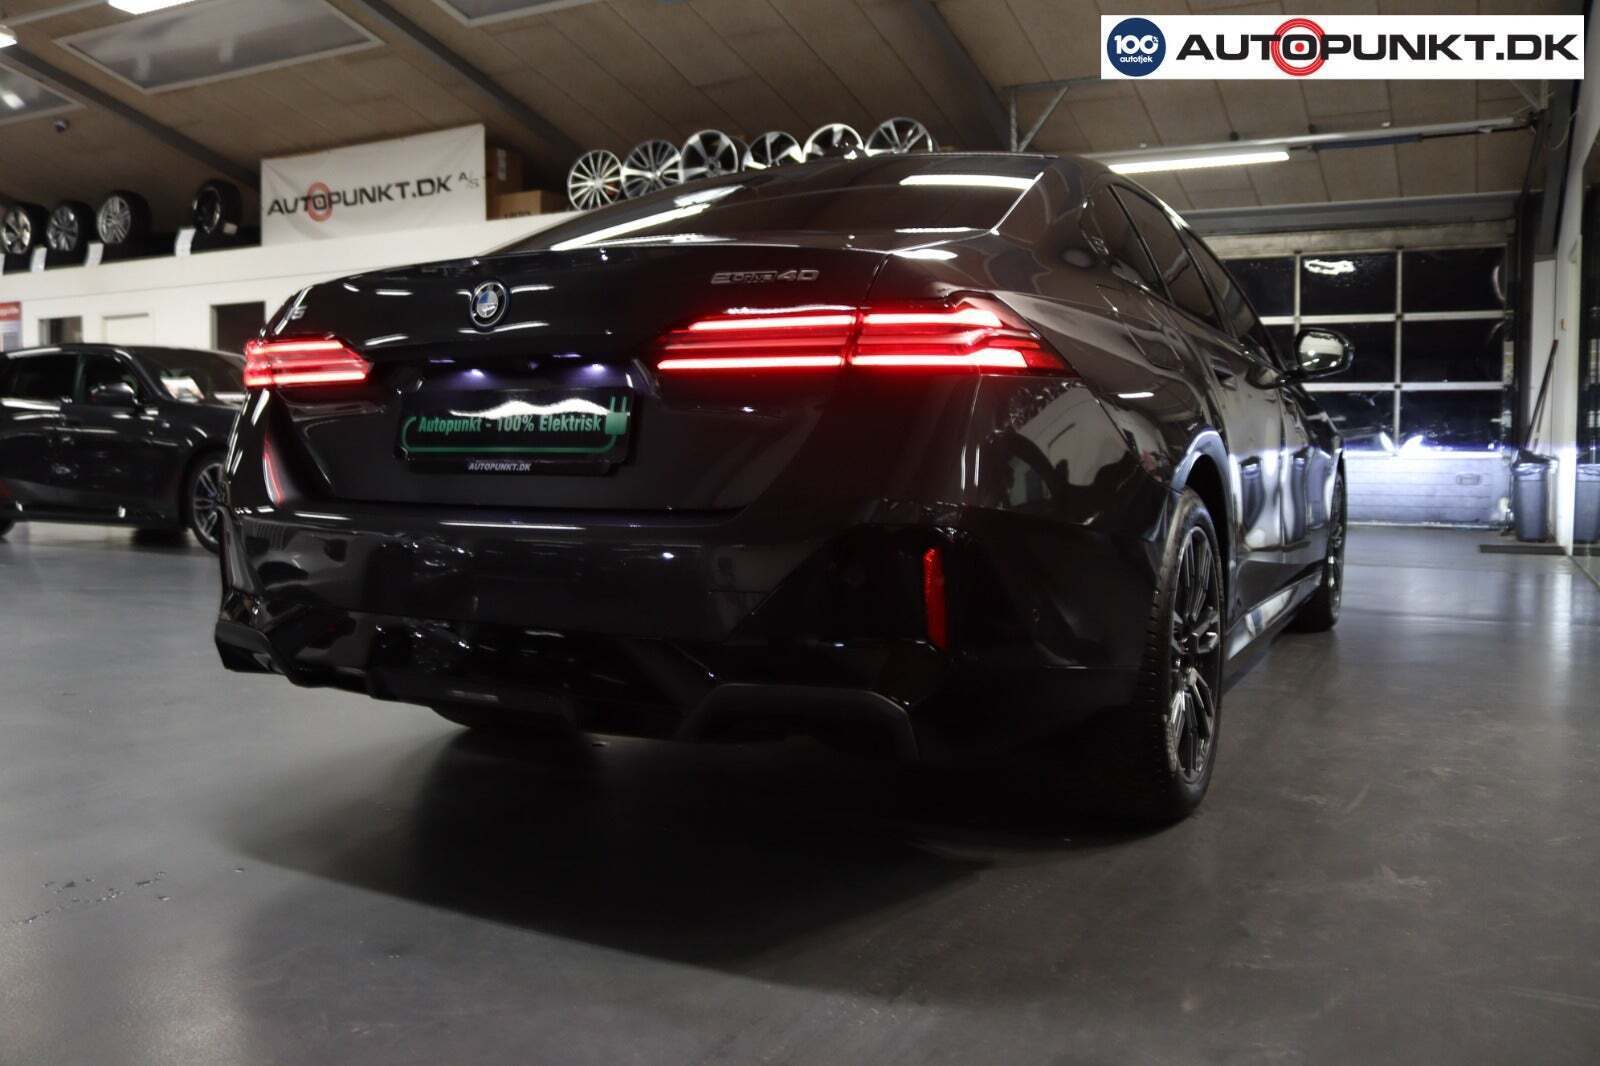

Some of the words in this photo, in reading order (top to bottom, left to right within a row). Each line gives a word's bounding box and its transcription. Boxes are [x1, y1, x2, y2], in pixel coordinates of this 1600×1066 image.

[267, 175, 452, 216] AUTOPUNKT.DK
[418, 415, 482, 436] Autopunkt
[497, 415, 535, 433] 100%
[539, 414, 601, 433] Elektrisk
[468, 462, 532, 472] AUTOPUNKT.DK
